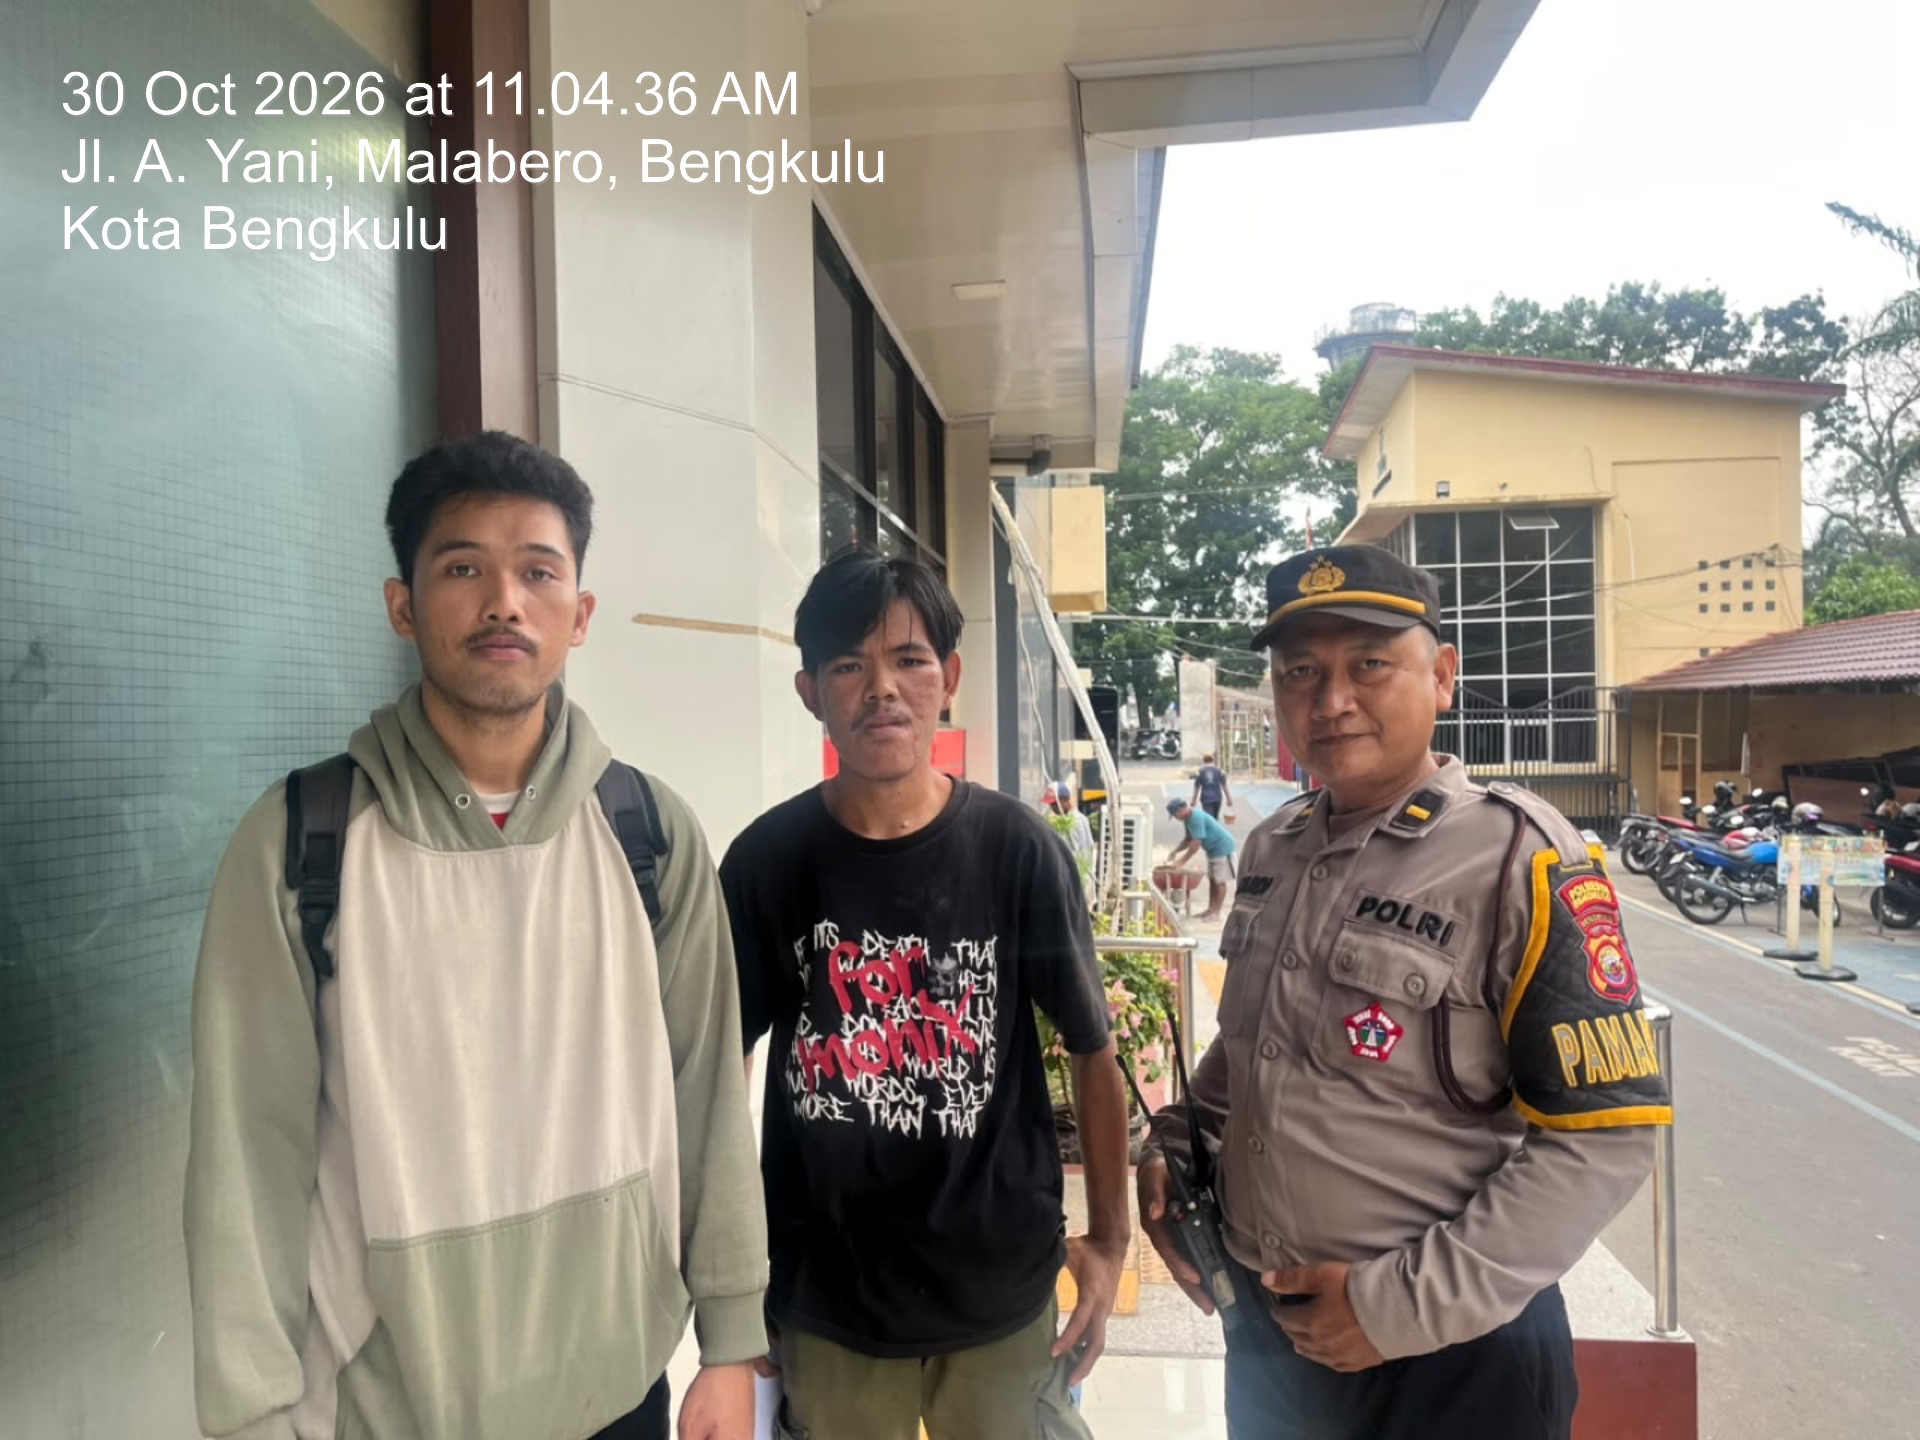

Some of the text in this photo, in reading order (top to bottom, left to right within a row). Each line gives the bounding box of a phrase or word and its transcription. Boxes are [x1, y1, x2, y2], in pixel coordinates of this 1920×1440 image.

[1355, 896, 1456, 947] POLRI
[950, 935, 998, 970] THAT
[861, 1095, 927, 1140] THAN
[931, 1104, 984, 1140] THAT
